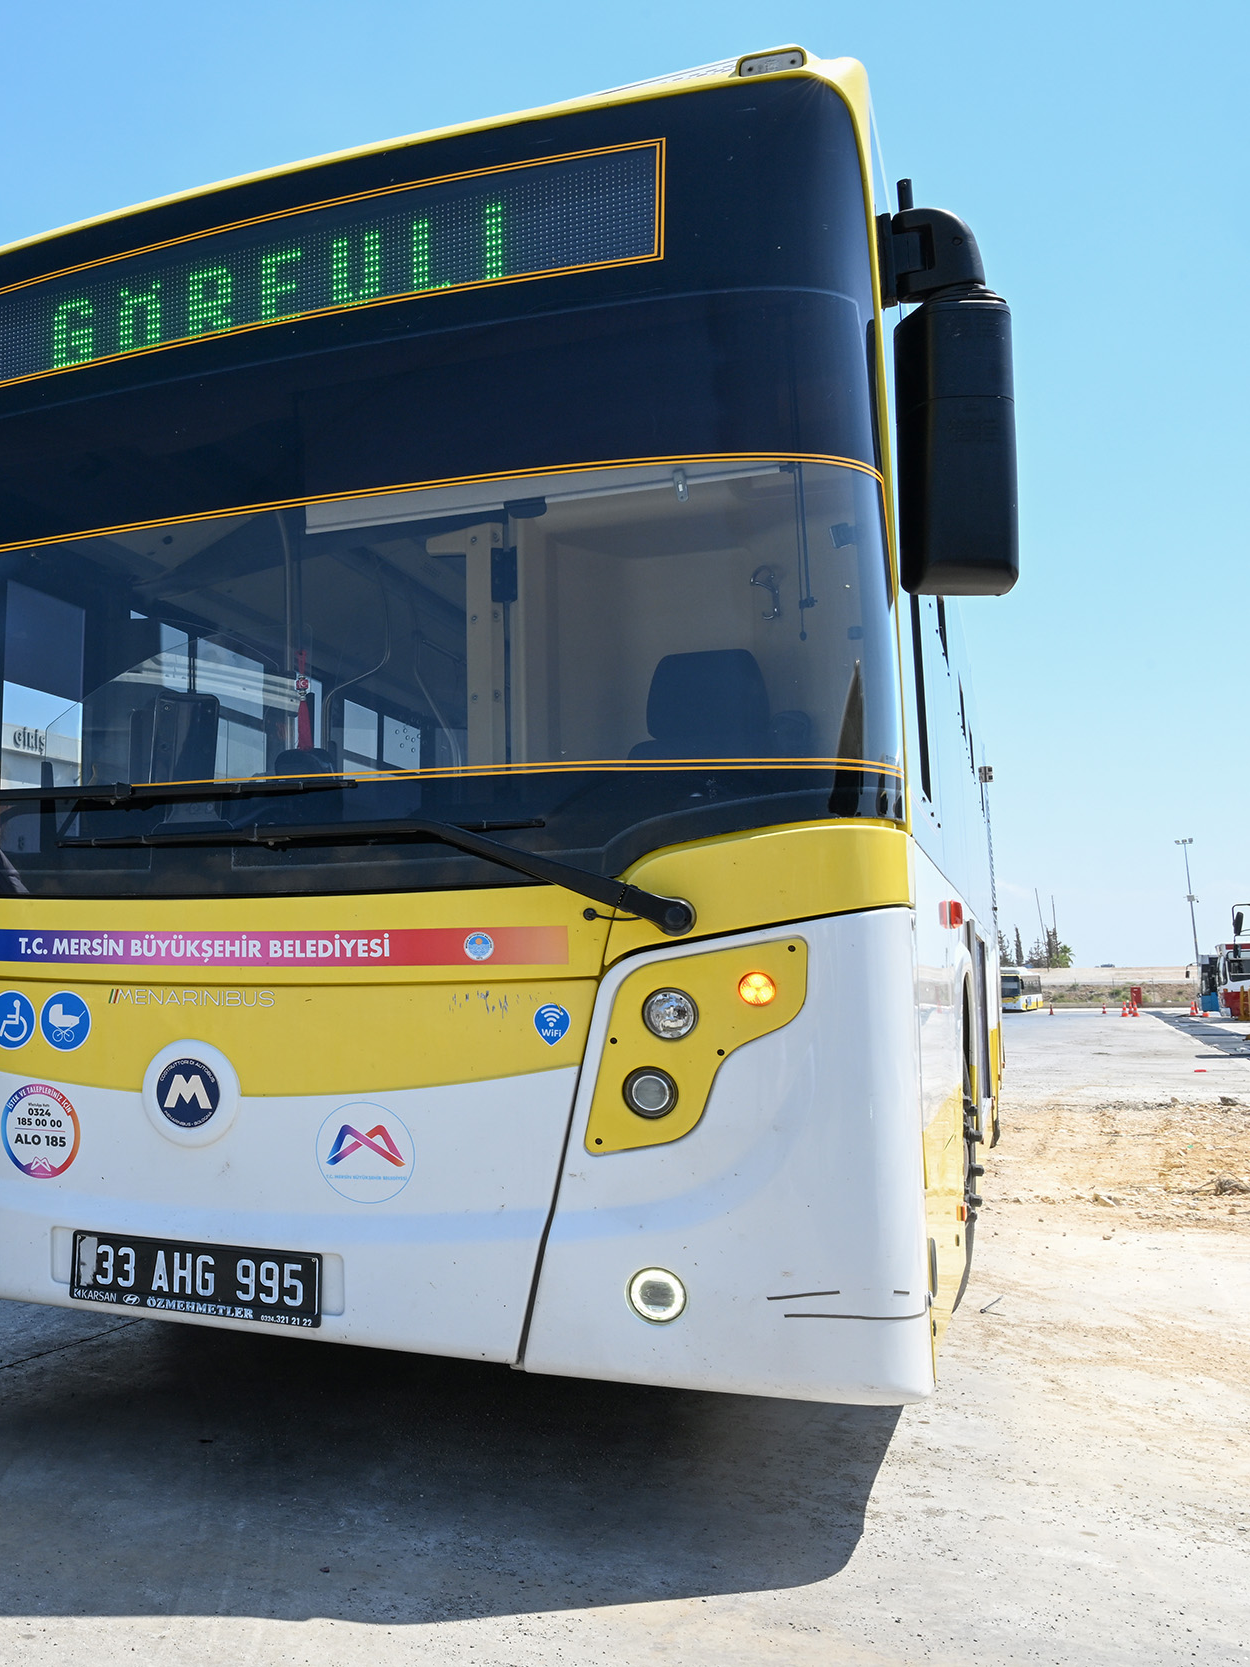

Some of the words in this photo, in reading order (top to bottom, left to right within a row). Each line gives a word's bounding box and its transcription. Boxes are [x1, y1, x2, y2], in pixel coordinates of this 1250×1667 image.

[18, 937, 48, 955] T.C.
[52, 933, 124, 956] MERSİN
[130, 933, 262, 963] BÜYÜKŞEHİR
[269, 932, 391, 958] BELEDİYESİ
[116, 988, 276, 1008] MENARINIBUS
[541, 1028, 562, 1038] WiFi
[27, 1107, 52, 1117] 0324
[17, 1117, 33, 1126] 185
[35, 1118, 47, 1127] 00
[50, 1119, 63, 1128] 00
[14, 1133, 42, 1146] ALO
[44, 1135, 67, 1148] 185
[95, 1244, 136, 1288] 33
[150, 1250, 215, 1297] AHG
[235, 1258, 304, 1308] 995
[81, 1288, 117, 1303] KARSAN
[146, 1295, 254, 1320] ÖZMEHMETLER
[291, 1316, 300, 1326] 21
[302, 1318, 313, 1327] 22
